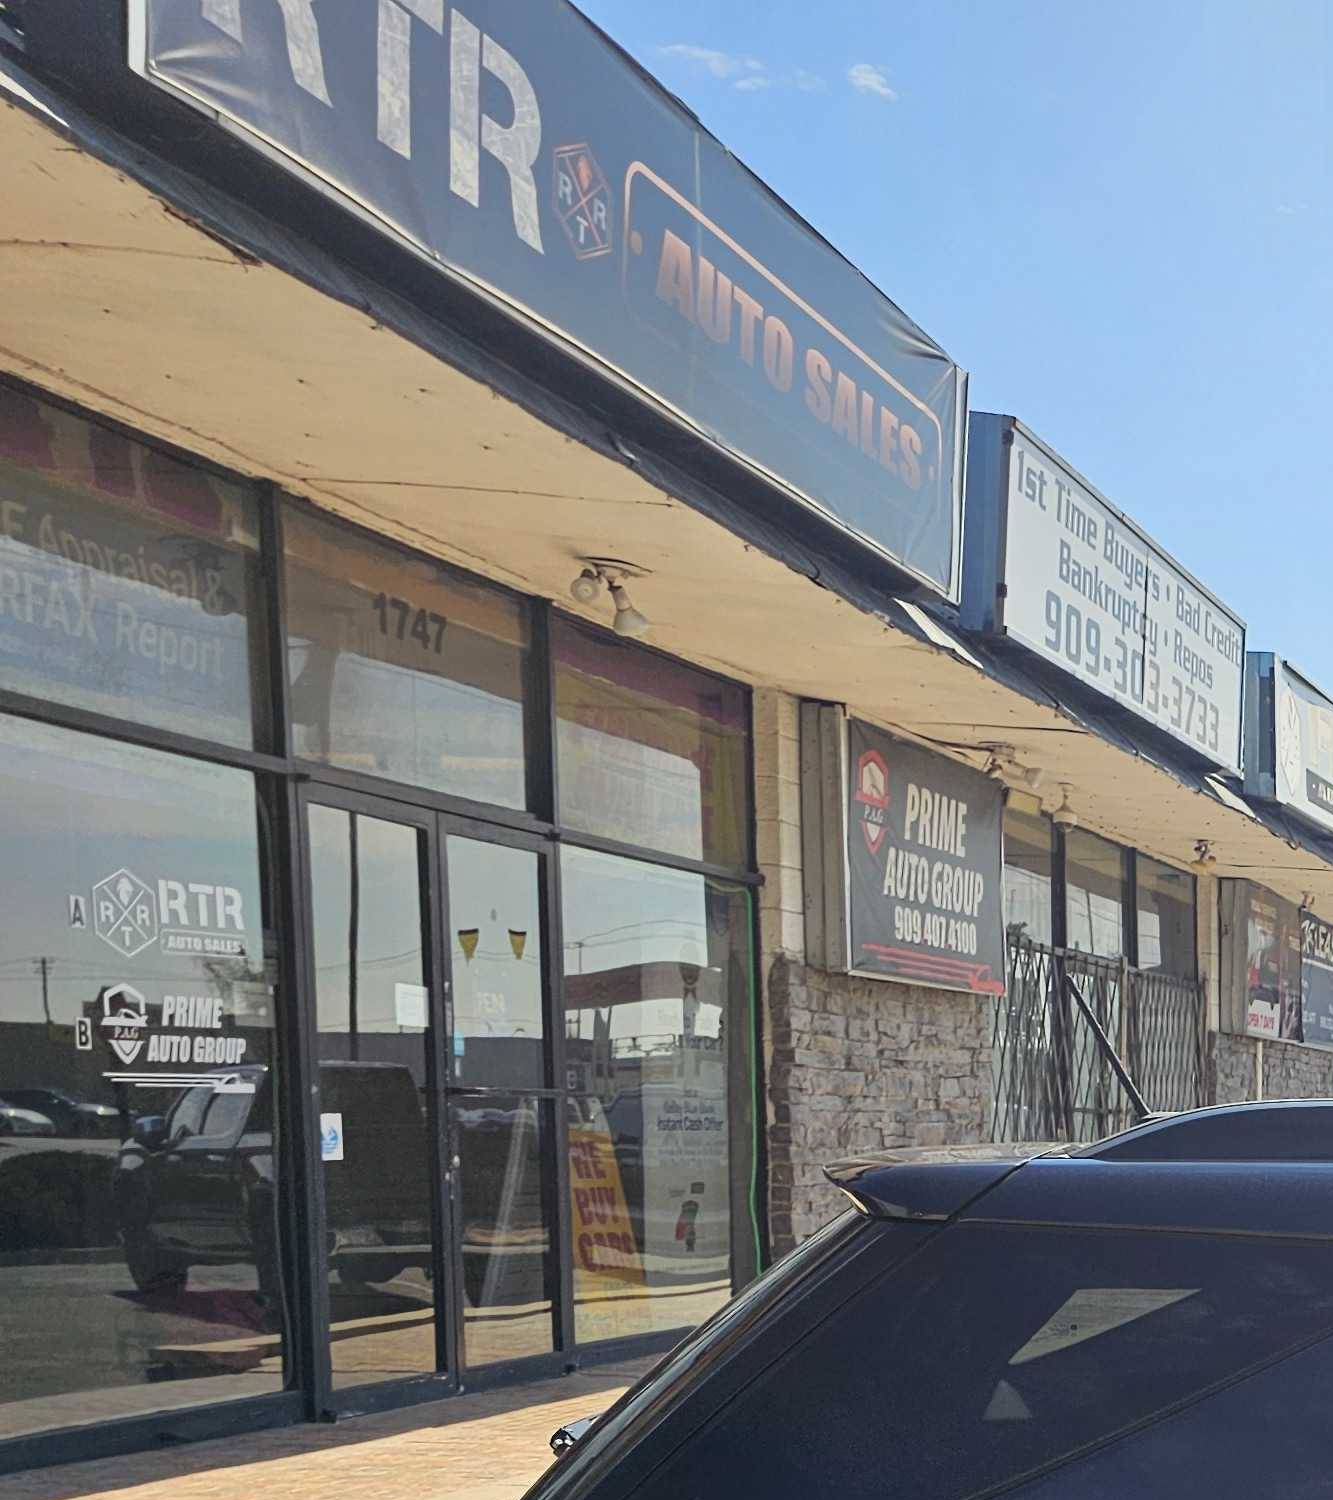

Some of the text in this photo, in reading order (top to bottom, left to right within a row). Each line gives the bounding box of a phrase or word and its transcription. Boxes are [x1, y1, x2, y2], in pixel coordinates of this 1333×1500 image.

[655, 228, 924, 489] AUTO SALES
[1017, 450, 1241, 668] 1st Time Buyers Bad Credit
[115, 600, 222, 677] Report
[373, 592, 447, 653] 1747
[1058, 537, 1213, 689] Bankruptcy Repos
[1044, 589, 1220, 753] 909-303-3733
[903, 783, 967, 857] PRIME
[158, 879, 246, 930] RTR
[883, 846, 984, 918] AUTO GROUP
[71, 898, 85, 927] A
[894, 905, 977, 956] 909 407 4100
[167, 935, 241, 953] AUTO SALES
[77, 1019, 89, 1047] B
[162, 995, 225, 1029] PRIME
[147, 1034, 246, 1065] AUTO GROUP
[574, 1187, 618, 1226] BUY
